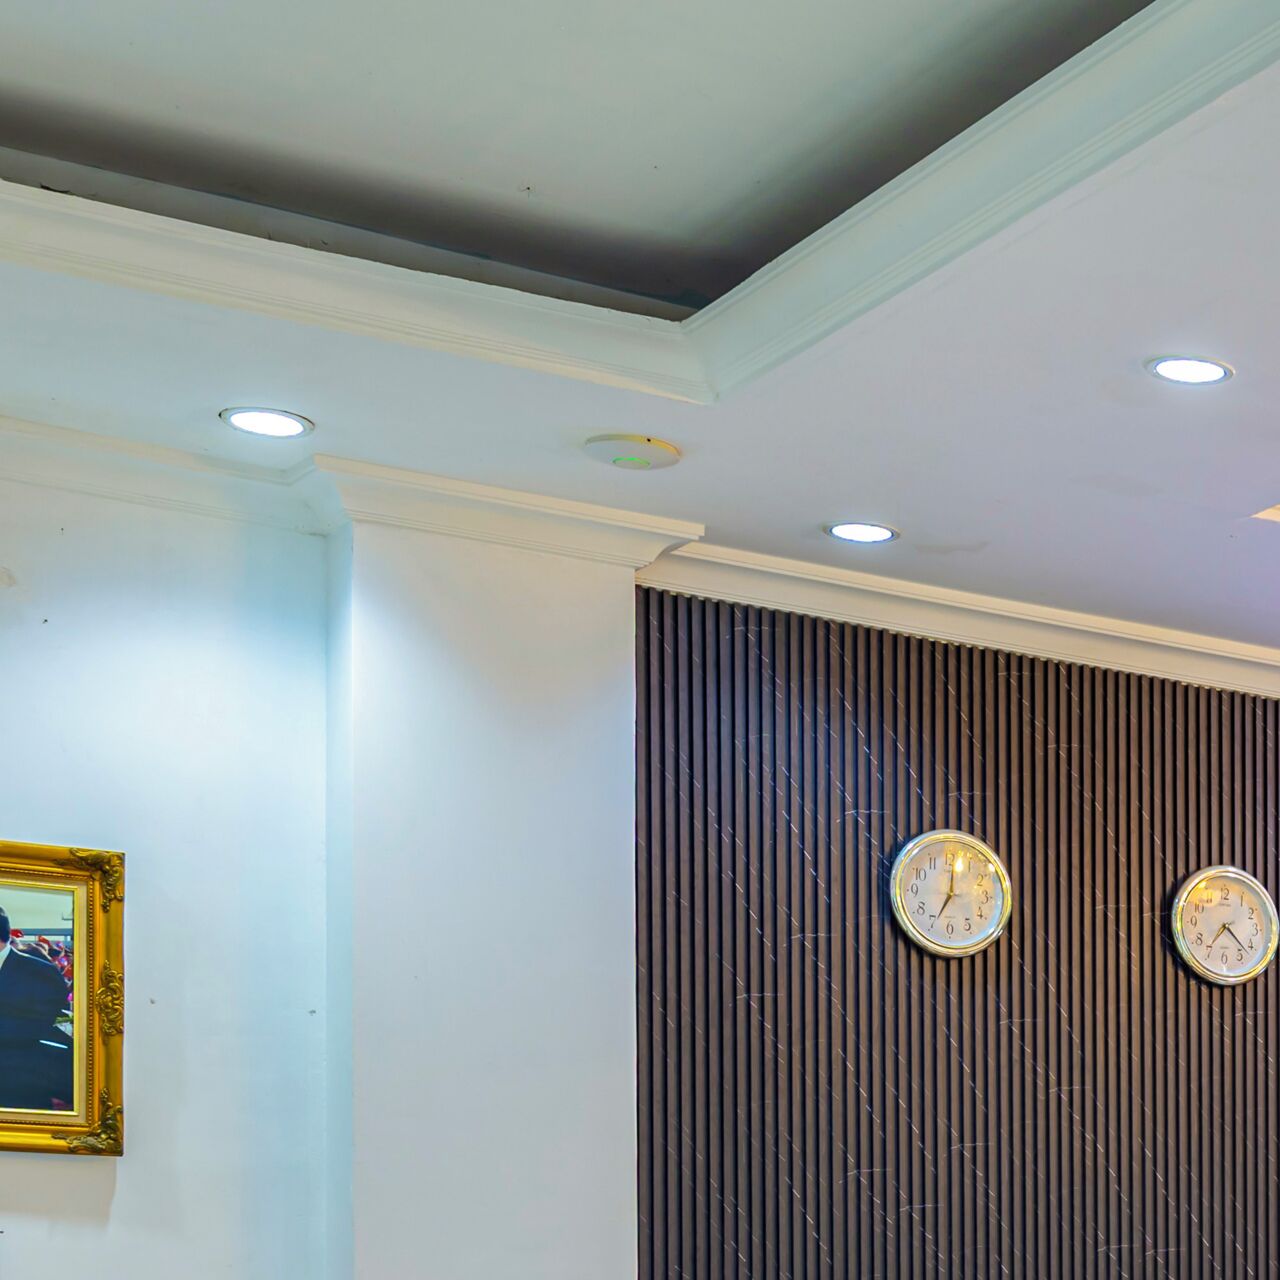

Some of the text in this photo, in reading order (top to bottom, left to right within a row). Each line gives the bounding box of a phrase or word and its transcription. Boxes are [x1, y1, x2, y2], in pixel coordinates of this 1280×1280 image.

[929, 857, 936, 870] 11
[916, 868, 926, 882] 10
[976, 874, 984, 886] 2
[910, 882, 919, 898] 9
[982, 889, 988, 904] 3
[1220, 888, 1230, 900] 12
[916, 902, 926, 916] 8
[976, 906, 984, 920] 4
[1194, 902, 1204, 914] 10
[1248, 907, 1254, 920] 2
[928, 914, 936, 928] 7
[946, 920, 954, 935] 6
[963, 918, 972, 932] 5
[1190, 915, 1198, 928] 9
[1252, 922, 1258, 936] 3
[1195, 932, 1203, 946] 8
[1248, 938, 1254, 950] 4
[1206, 945, 1212, 959] 7
[1220, 950, 1228, 964] 6
[1236, 948, 1243, 962] 5
